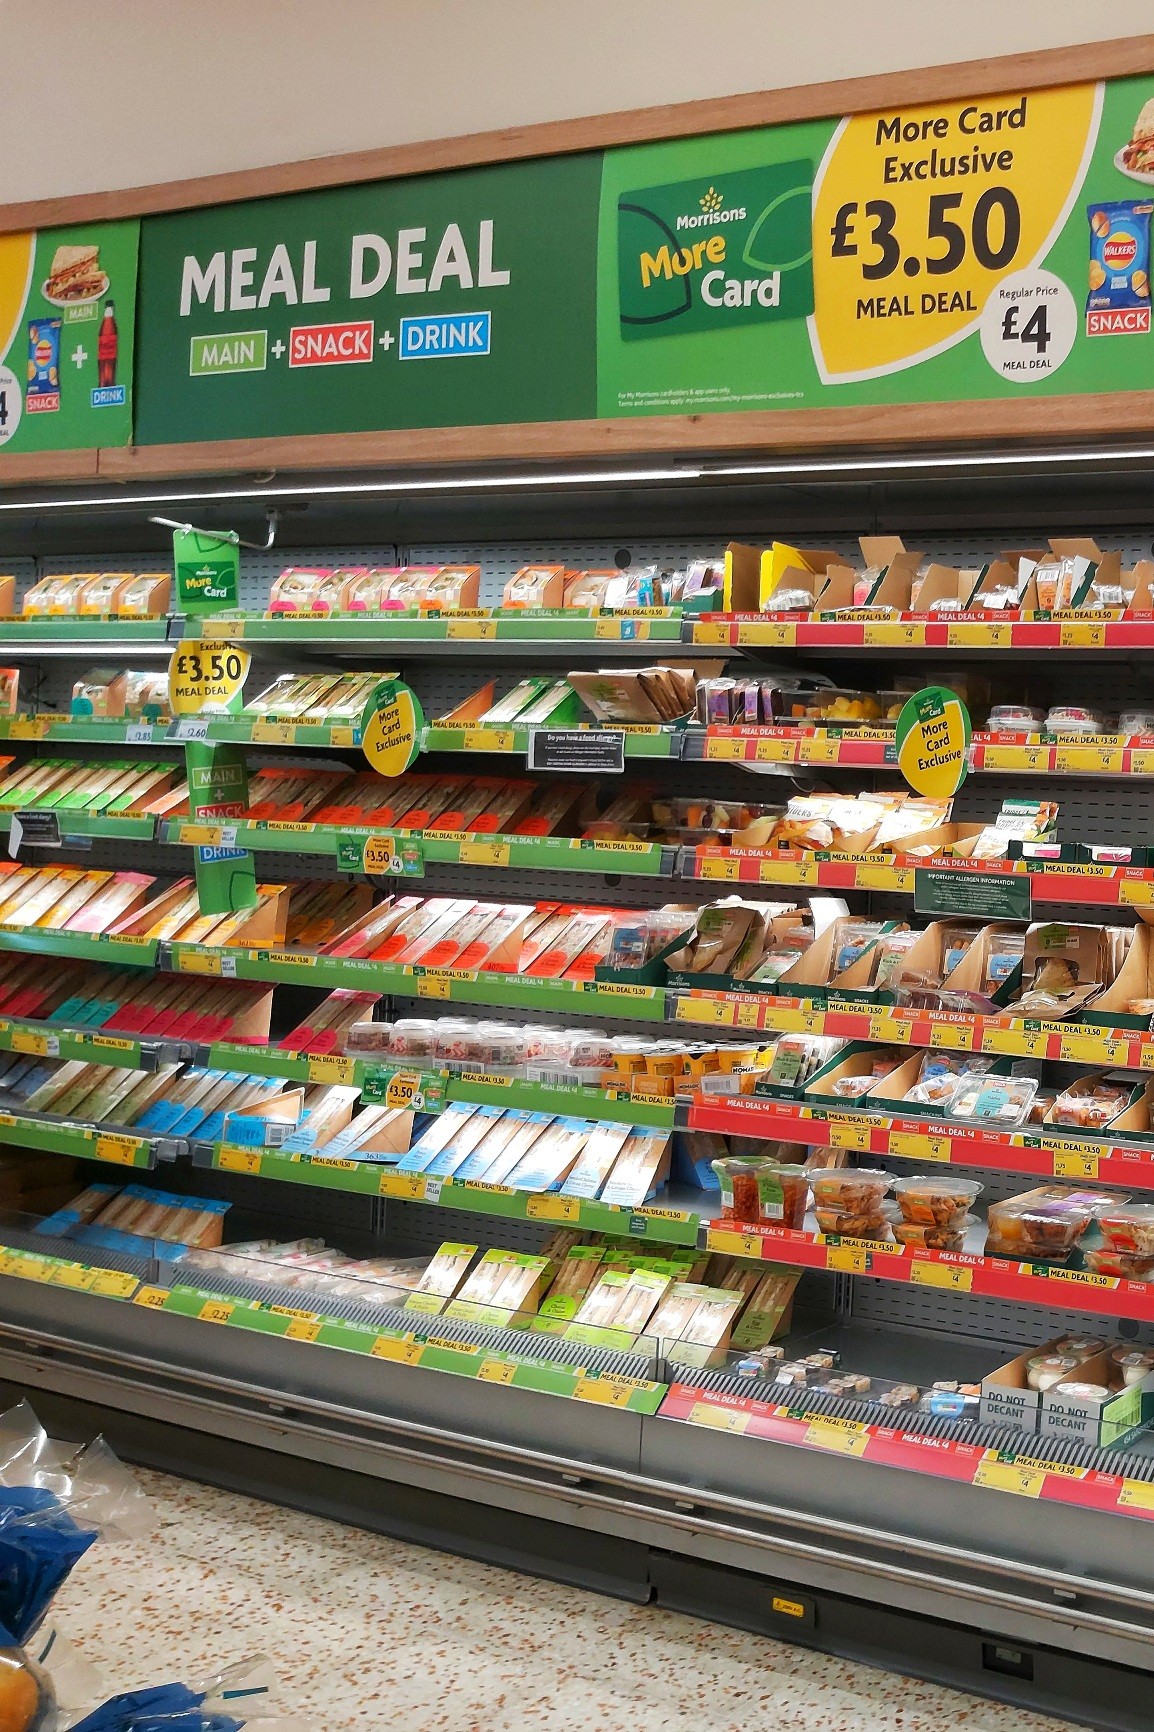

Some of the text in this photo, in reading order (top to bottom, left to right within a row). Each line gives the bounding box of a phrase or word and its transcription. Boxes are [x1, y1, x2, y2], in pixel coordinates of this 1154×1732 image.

[875, 97, 1028, 147] More Card
[883, 144, 1014, 184] Exclusive
[676, 207, 747, 231] Morrisons
[829, 186, 1022, 281] £3.50
[1104, 244, 1137, 257] WALKERS
[179, 219, 511, 317] MEAL DEAL
[640, 235, 727, 289] More
[701, 270, 781, 307] Card
[999, 284, 1059, 301] Regular Price
[856, 291, 978, 320] MEAL DEAL
[1001, 305, 1051, 354] £4
[1090, 312, 1148, 332] SNACK
[200, 339, 255, 368] MAIN
[294, 328, 369, 359] SNACK
[406, 318, 484, 351] DRINK
[1003, 359, 1052, 371] MEAL DEAL
[27, 397, 59, 411] SNACK
[93, 389, 123, 404] DRINK
[185, 577, 212, 590] More
[204, 585, 227, 598] Card
[1052, 610, 1112, 619] MEAL DEAL £3.50
[176, 655, 242, 683] £3.50
[175, 685, 229, 697] MEAL DEAL
[378, 708, 400, 725] More
[381, 720, 401, 736] Card
[920, 719, 949, 738] More
[375, 733, 412, 753] Exclusive
[925, 734, 951, 754] Card
[917, 748, 962, 771] Exclusive
[200, 770, 235, 784] MAIN
[199, 804, 243, 818] SNACK
[365, 850, 390, 864] £3.50
[1044, 864, 1104, 875] MEAL DEAL £3.50
[927, 873, 1016, 887] IMPORTANT ALLERGEN INFORMATION
[389, 1085, 413, 1098] £3.50
[988, 1392, 1026, 1407] DO NOT
[986, 1402, 1024, 1419] DECANT
[1049, 1404, 1088, 1419] DO NOT
[1048, 1415, 1087, 1433] DECANT
[1016, 1456, 1076, 1475] MEAL DEAL £3.50
